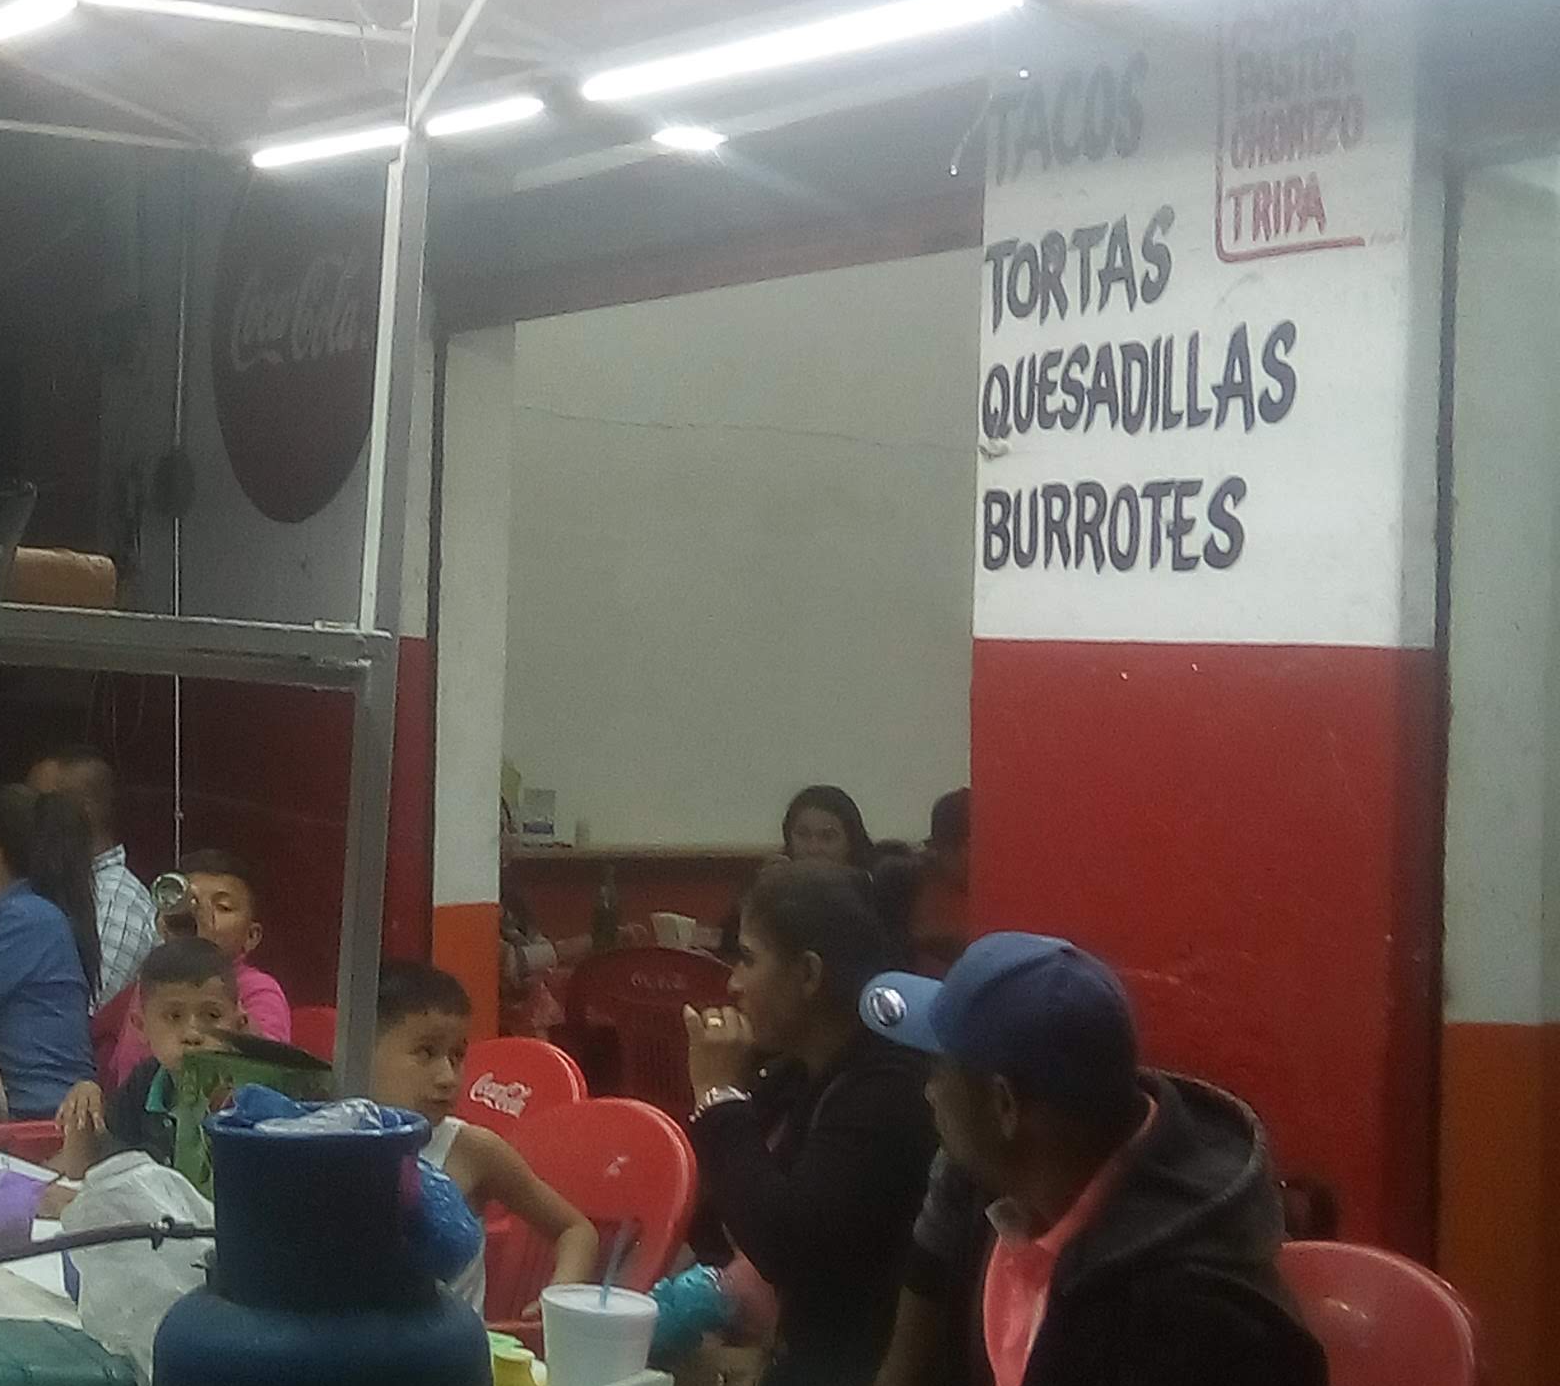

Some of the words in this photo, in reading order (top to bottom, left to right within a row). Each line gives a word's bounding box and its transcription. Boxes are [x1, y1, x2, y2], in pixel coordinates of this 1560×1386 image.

[987, 50, 1149, 186] TACOS
[1229, 94, 1365, 169] CHORIZO
[1225, 172, 1328, 244] TRIPA
[984, 204, 1176, 333] TORTAS
[981, 319, 1298, 439] QUESADILLAS
[982, 476, 1247, 574] BURROTES
